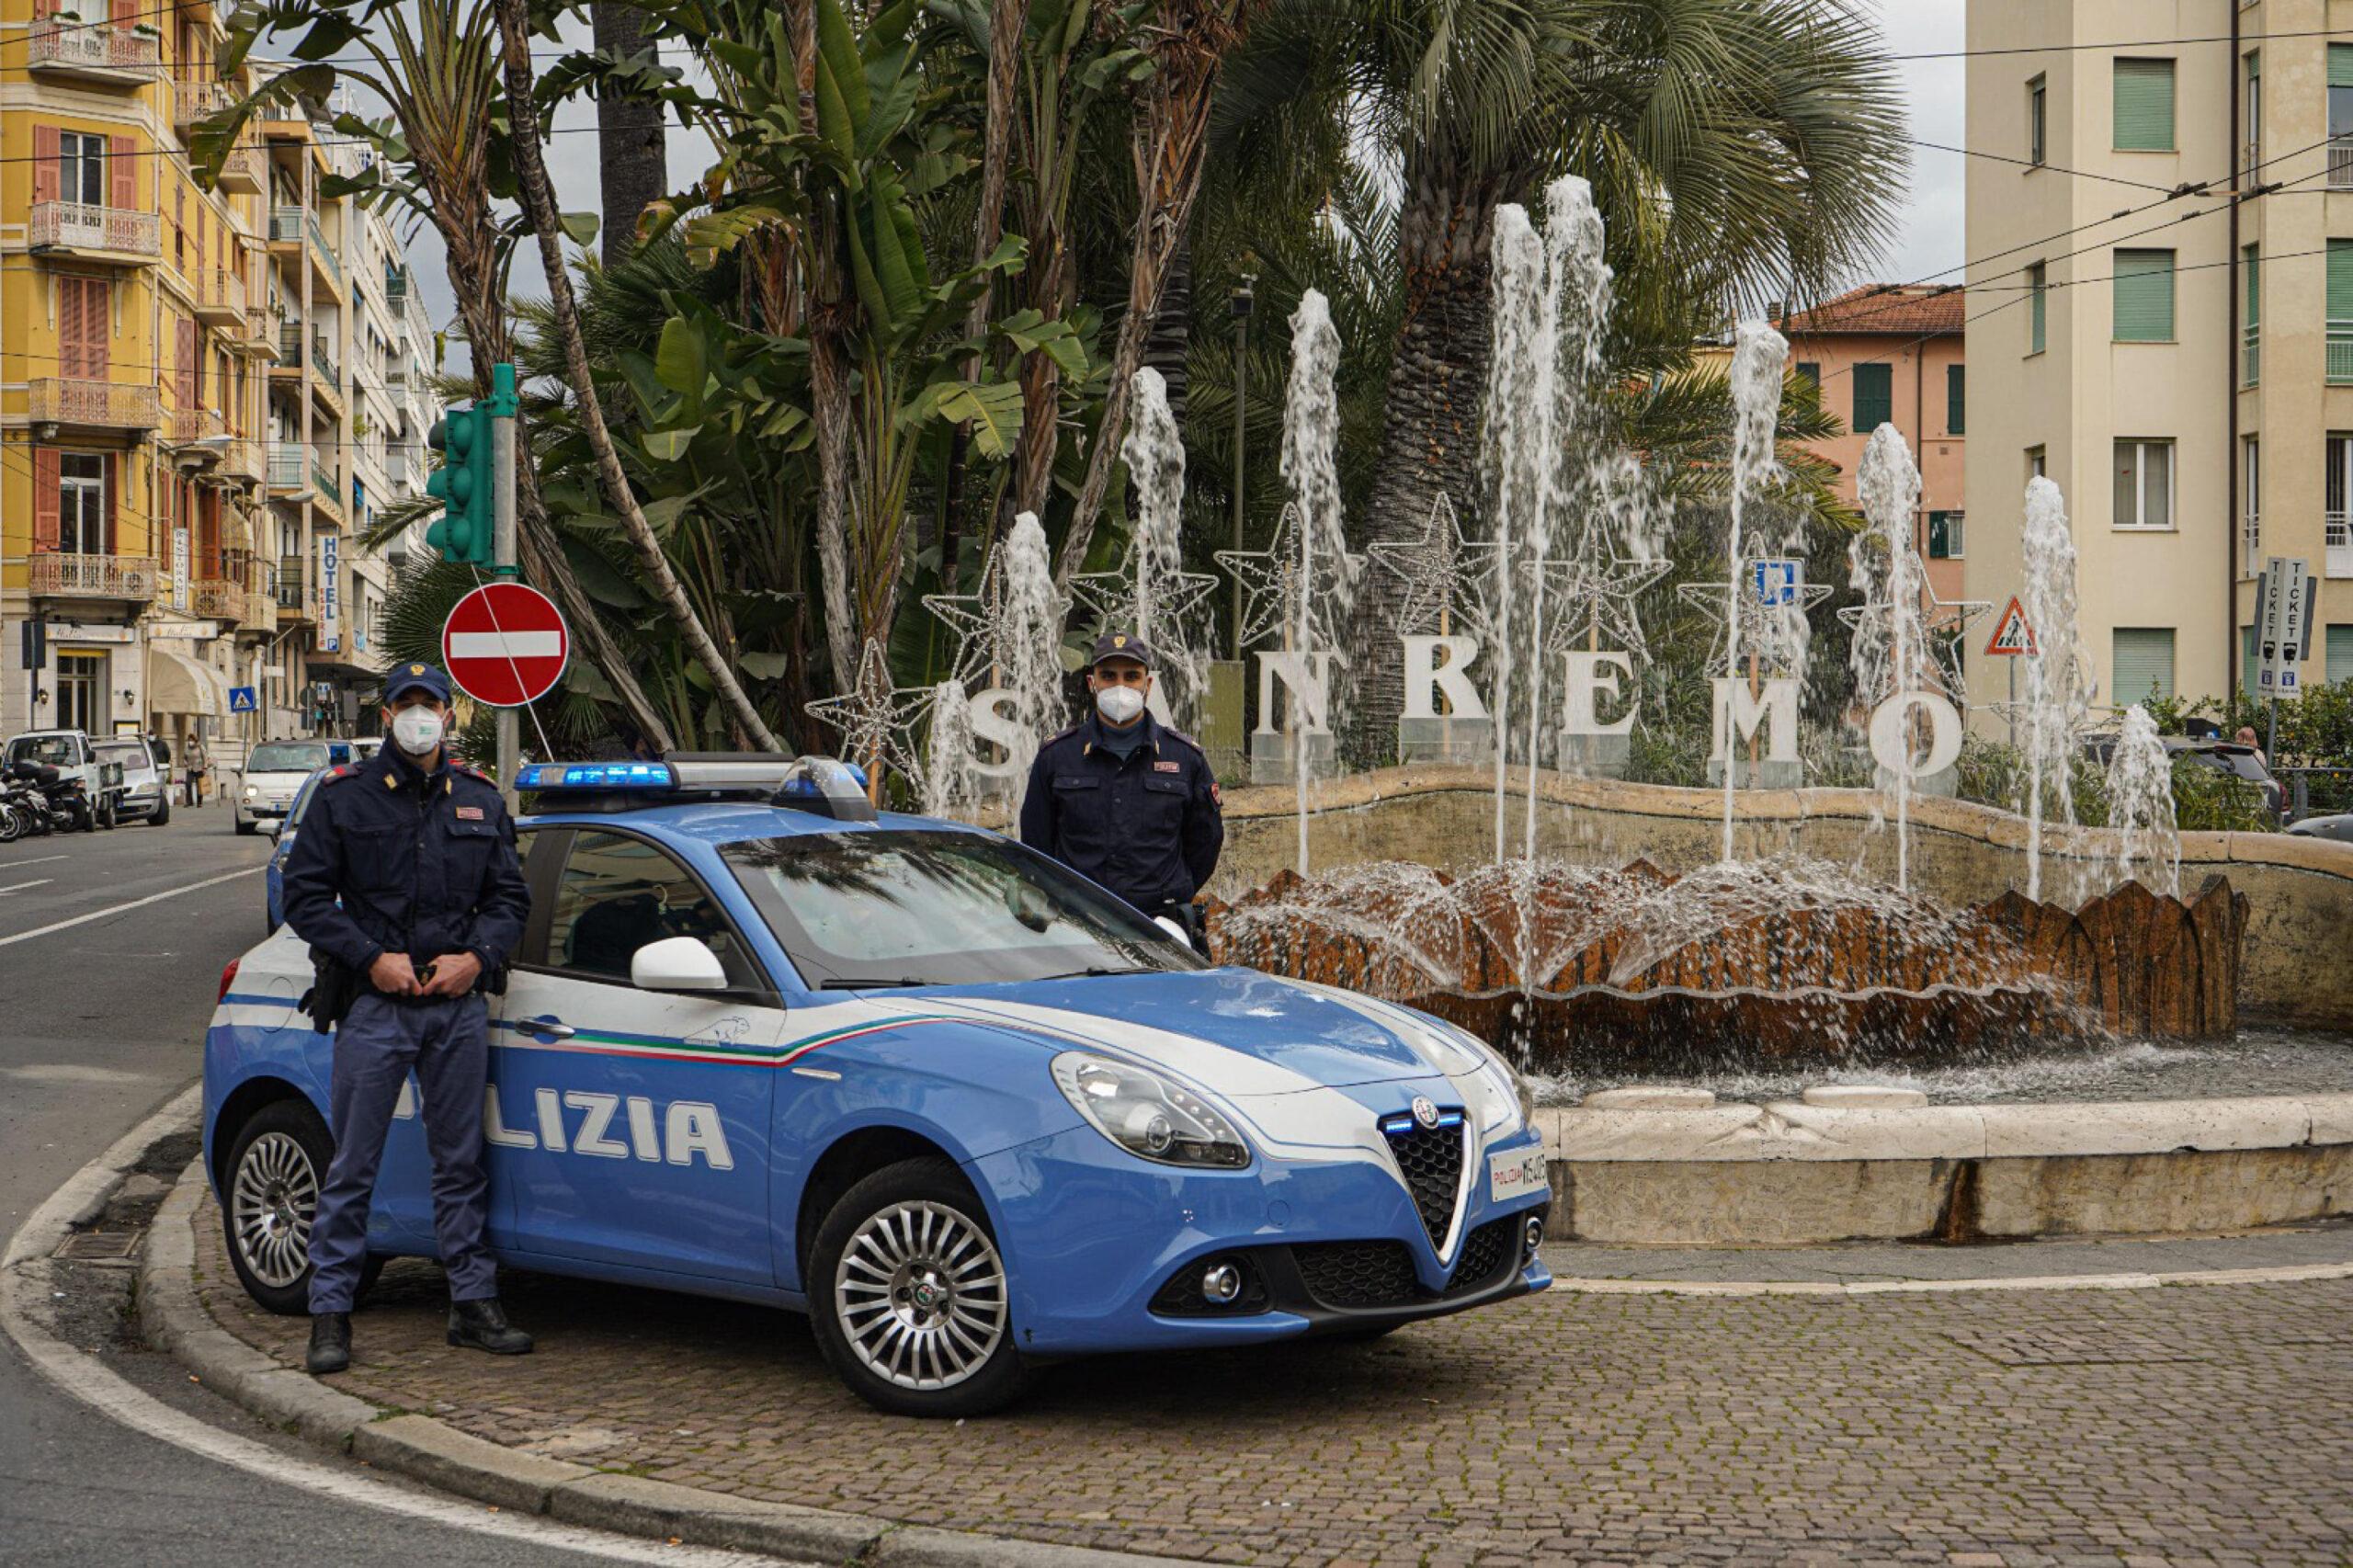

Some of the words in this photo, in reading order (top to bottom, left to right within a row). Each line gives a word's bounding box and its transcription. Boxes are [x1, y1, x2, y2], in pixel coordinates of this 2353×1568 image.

[324, 538, 336, 619] HOTEL
[2268, 561, 2279, 636] TICKET
[2288, 562, 2301, 638] TICKET
[392, 1078, 734, 1171] LIZIA
